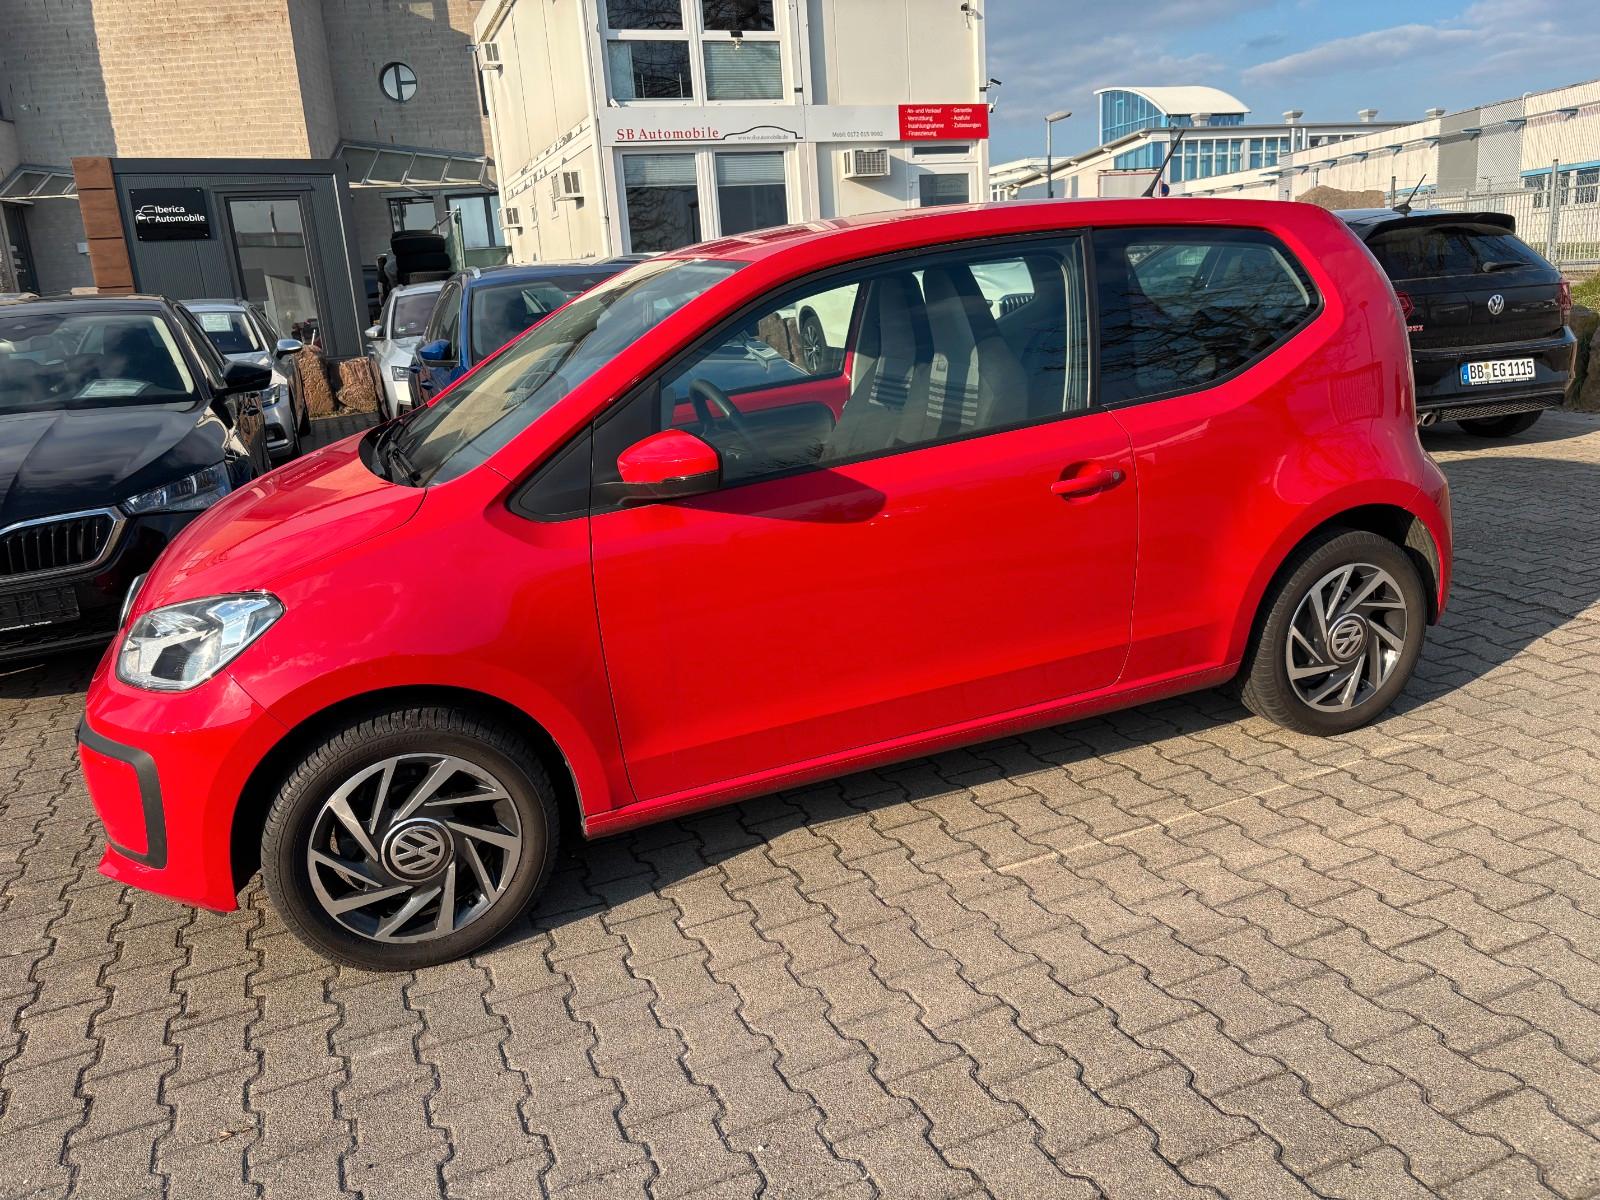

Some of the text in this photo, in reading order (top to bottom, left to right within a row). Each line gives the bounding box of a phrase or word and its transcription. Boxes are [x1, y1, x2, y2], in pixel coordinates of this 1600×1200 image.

[616, 127, 719, 141] SB Automobile
[155, 214, 205, 222] Automobile
[1469, 360, 1533, 380] BB EG 1115
